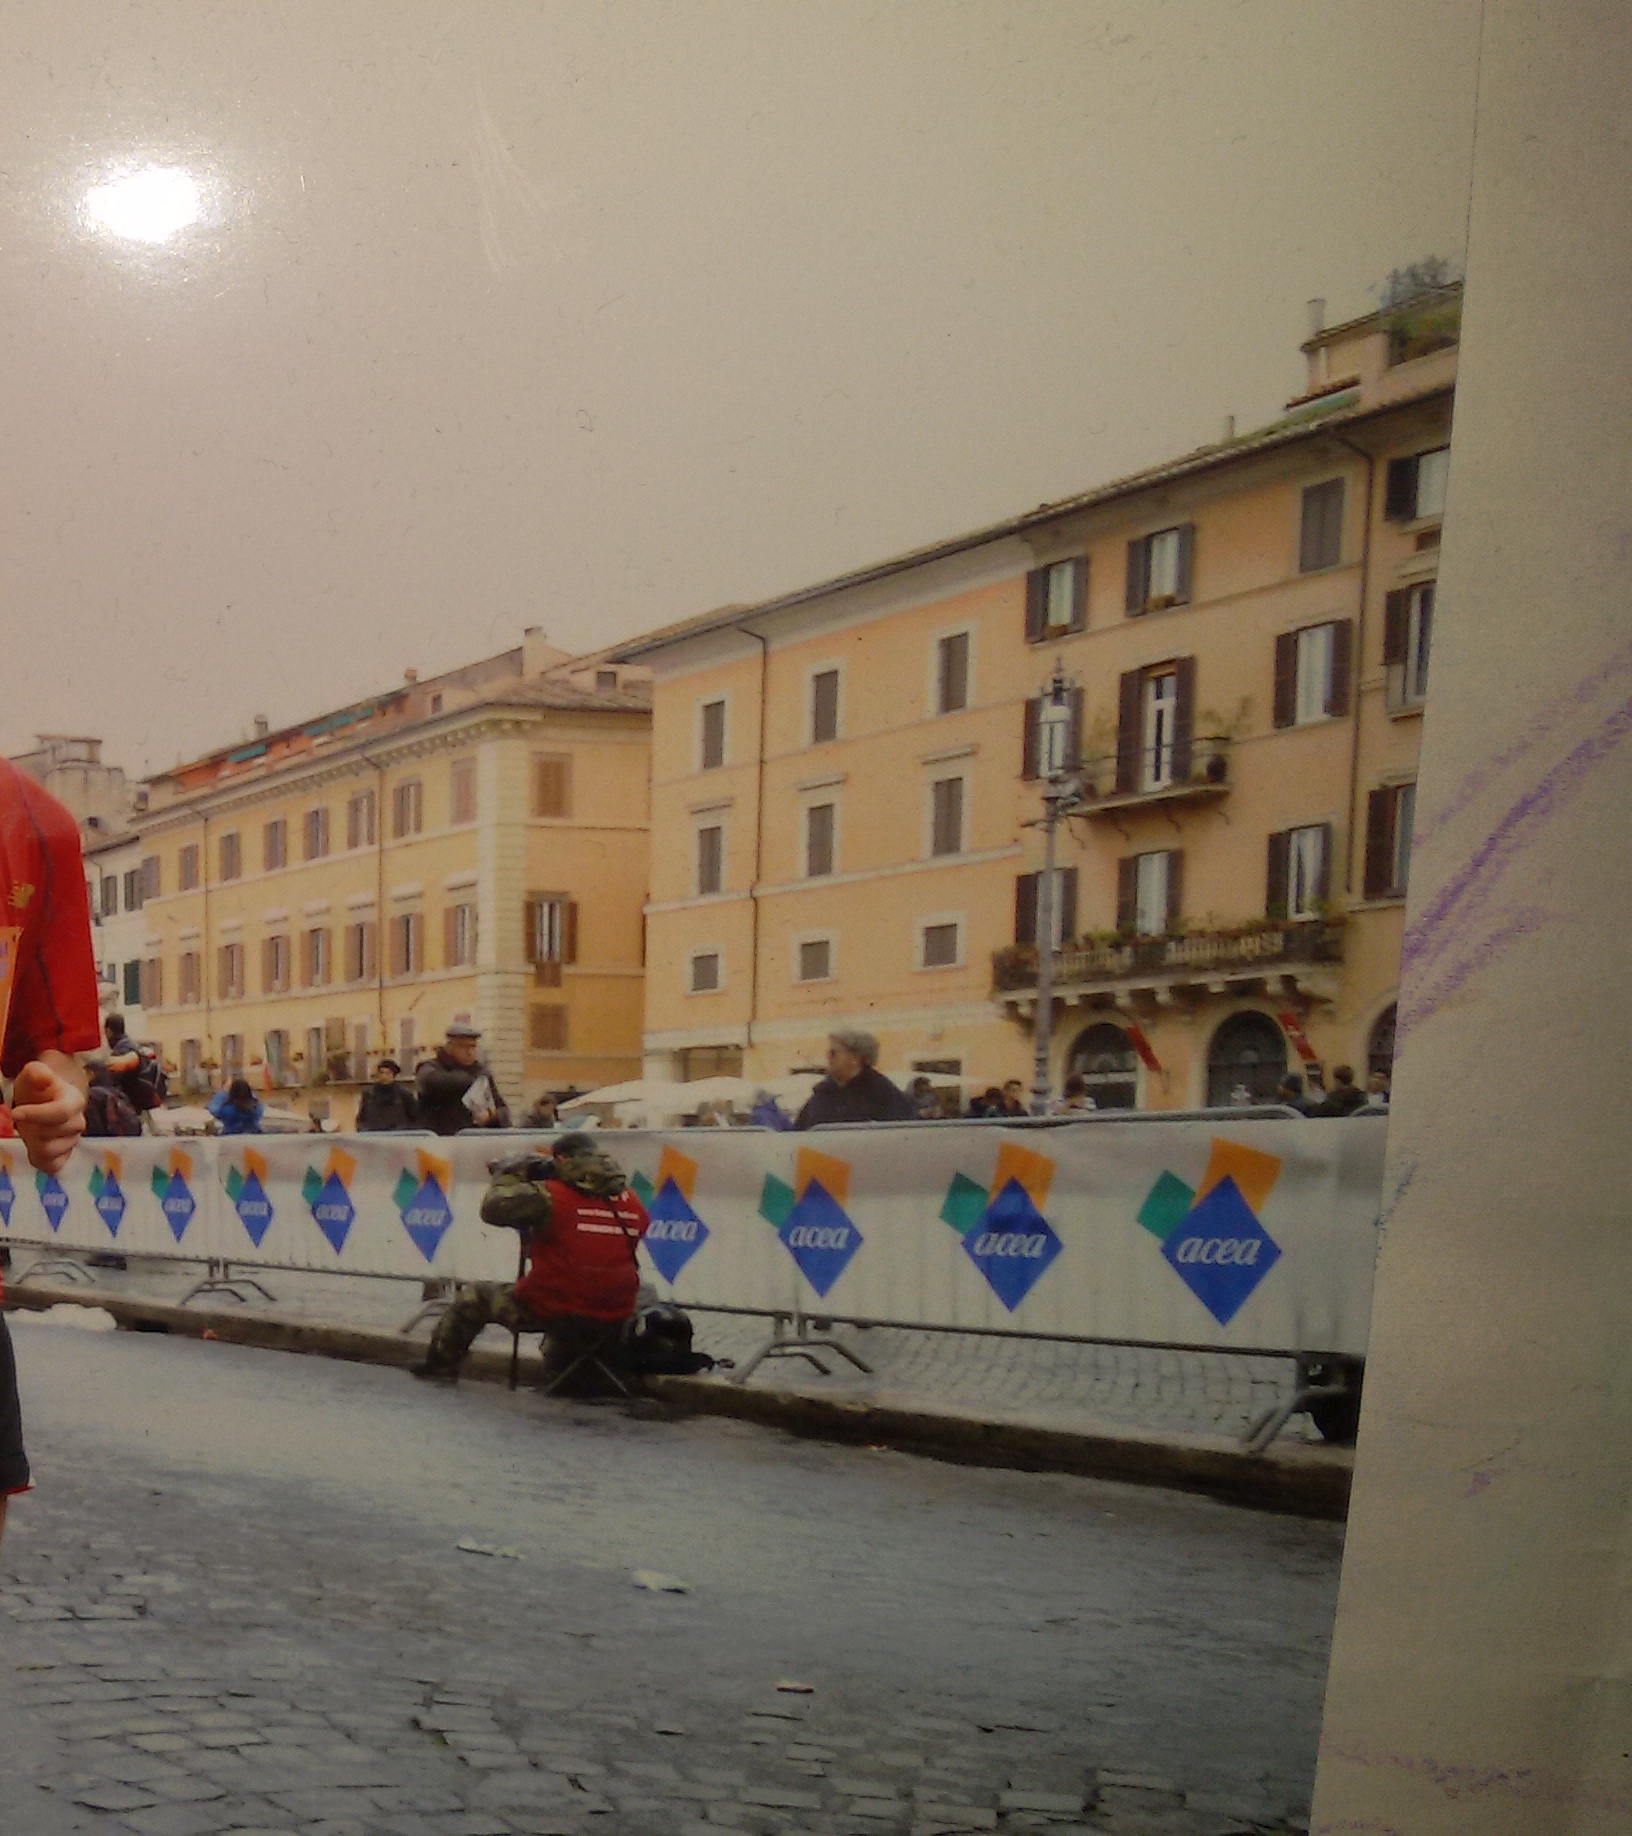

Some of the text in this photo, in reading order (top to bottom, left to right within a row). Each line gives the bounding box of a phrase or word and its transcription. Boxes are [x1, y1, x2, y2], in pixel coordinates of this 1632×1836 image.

[404, 1207, 446, 1226] acea
[646, 1219, 698, 1241] acea
[789, 1225, 849, 1249] acea
[973, 1231, 1048, 1259] acea
[1176, 1236, 1262, 1266] acea
